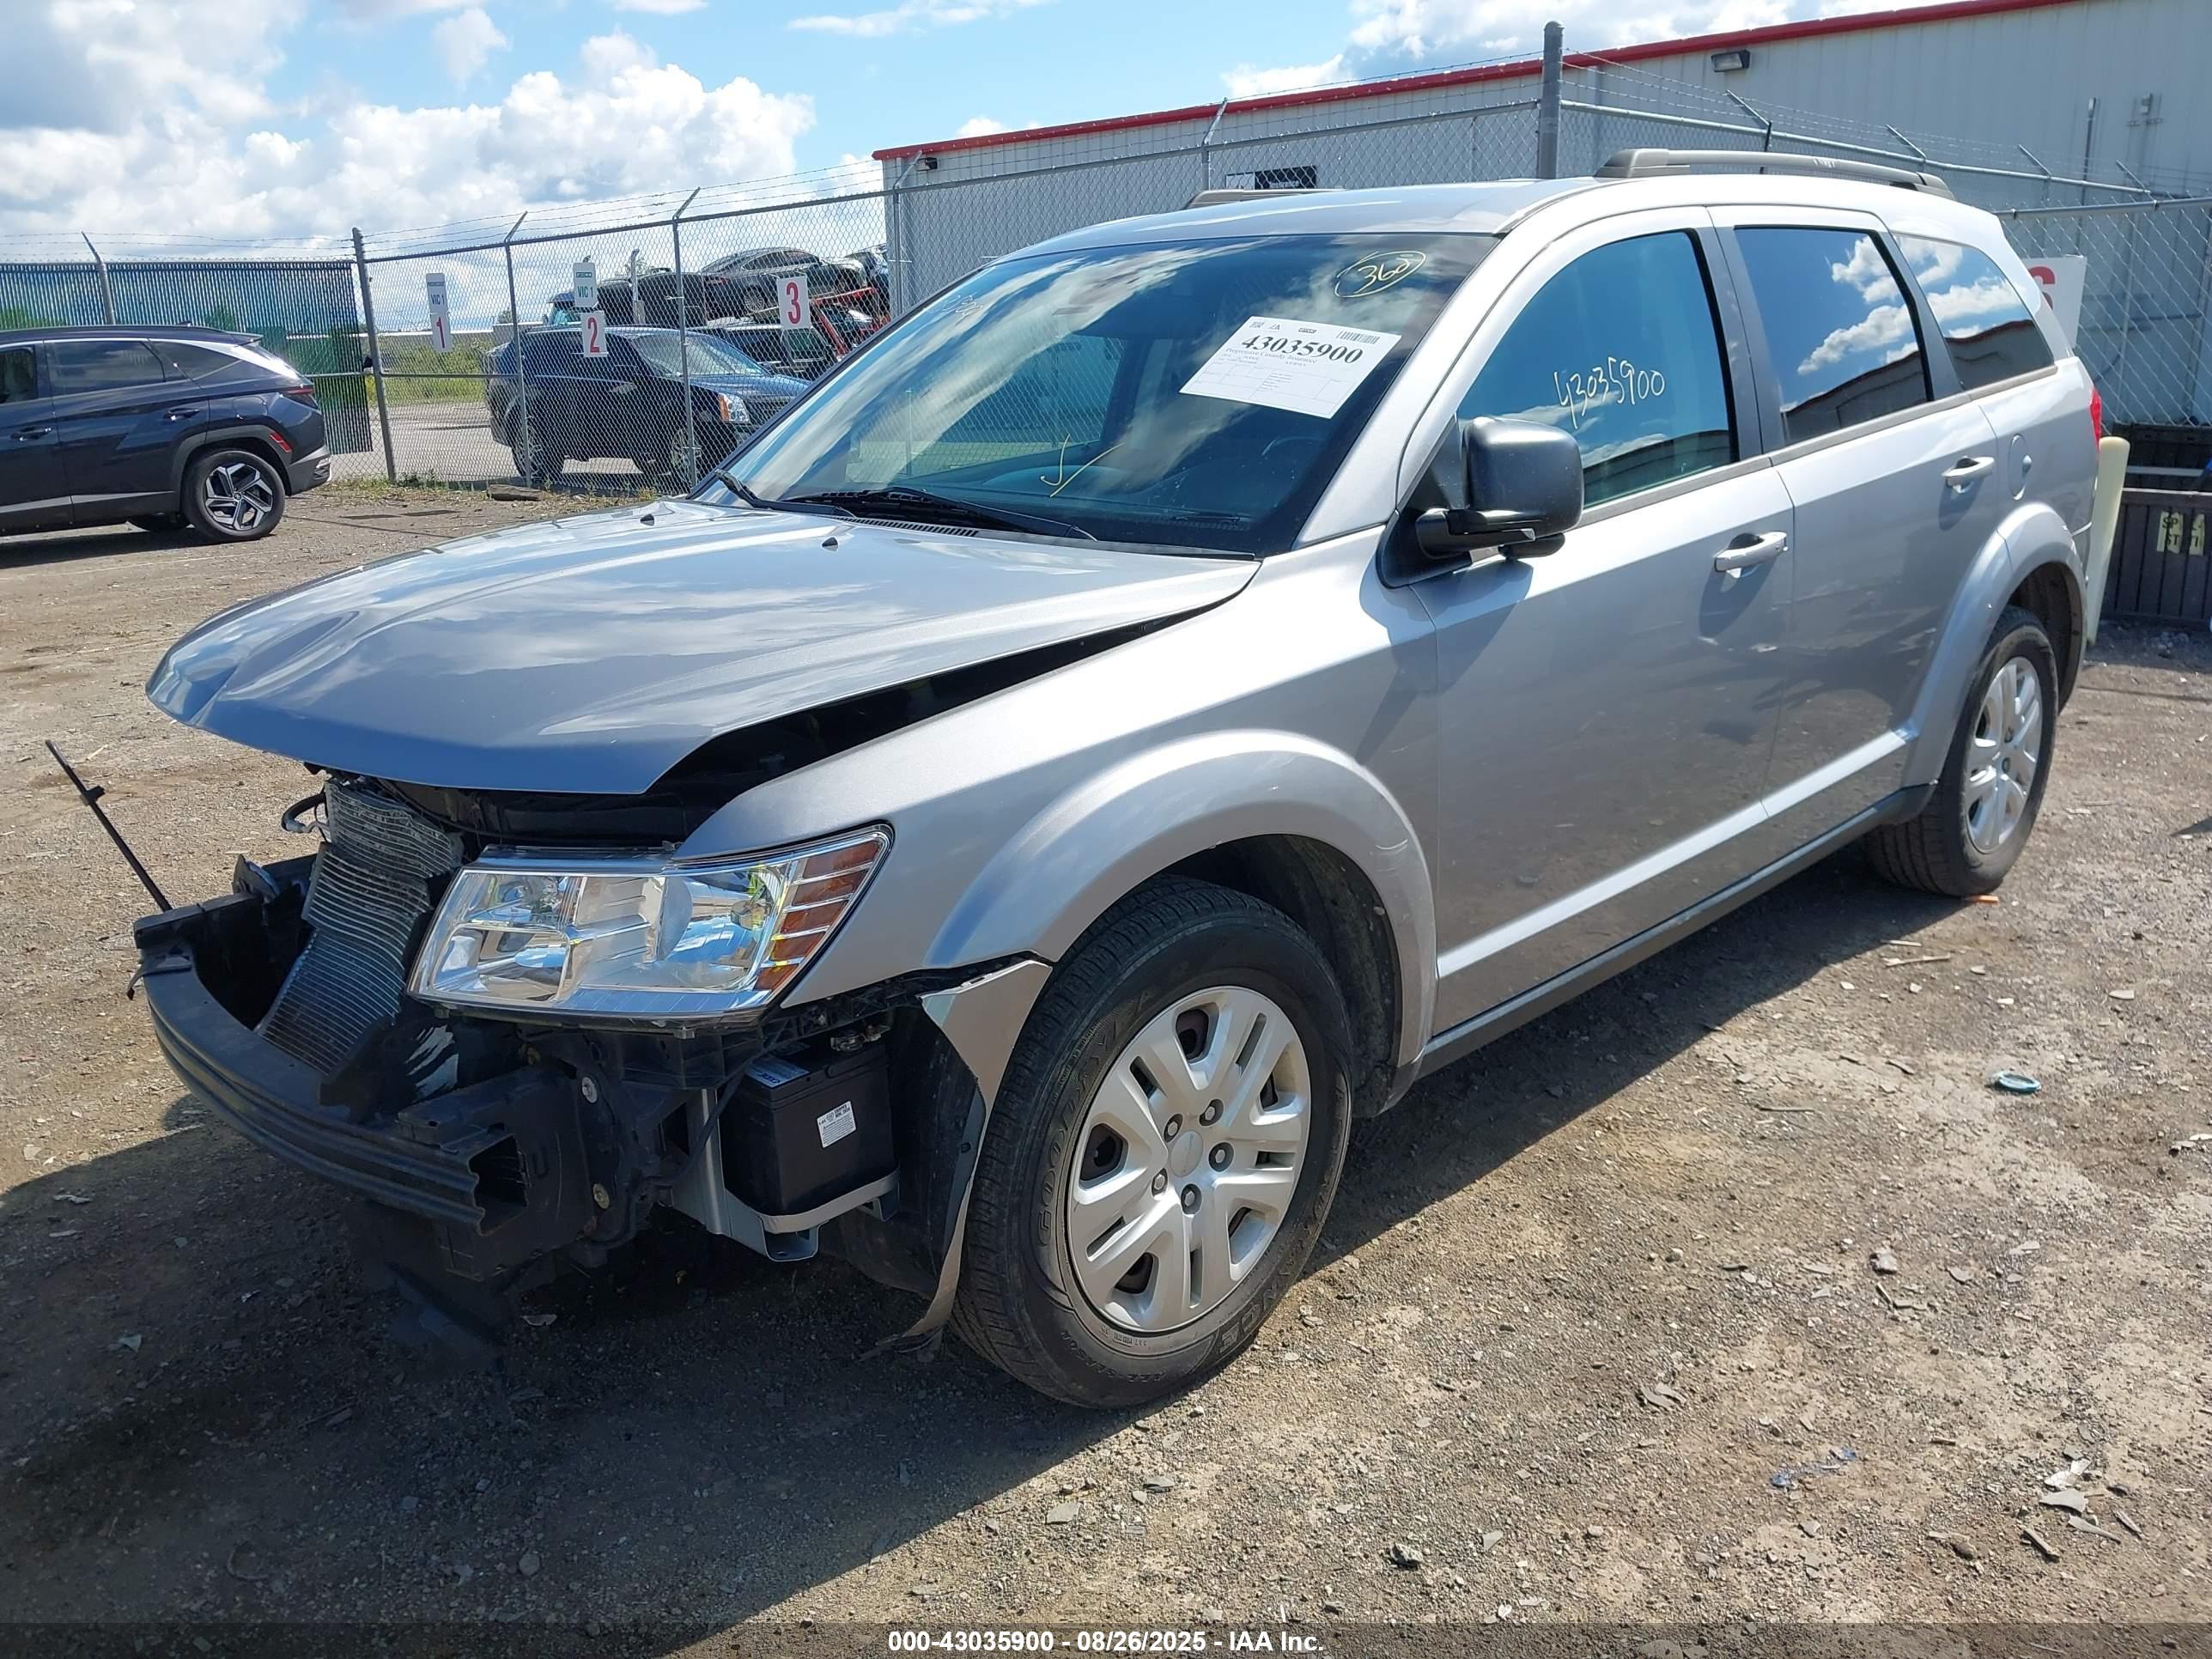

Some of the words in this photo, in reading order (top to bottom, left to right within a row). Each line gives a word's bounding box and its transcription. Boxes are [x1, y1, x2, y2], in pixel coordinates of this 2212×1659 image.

[576, 285, 589, 298] VIC
[1353, 257, 1410, 294] 360
[430, 294, 441, 305] VIC
[786, 282, 801, 325] 3
[435, 316, 446, 349] 1
[587, 317, 600, 353] 2
[1242, 335, 1364, 365] 43035900
[1553, 357, 1665, 429] 43035900
